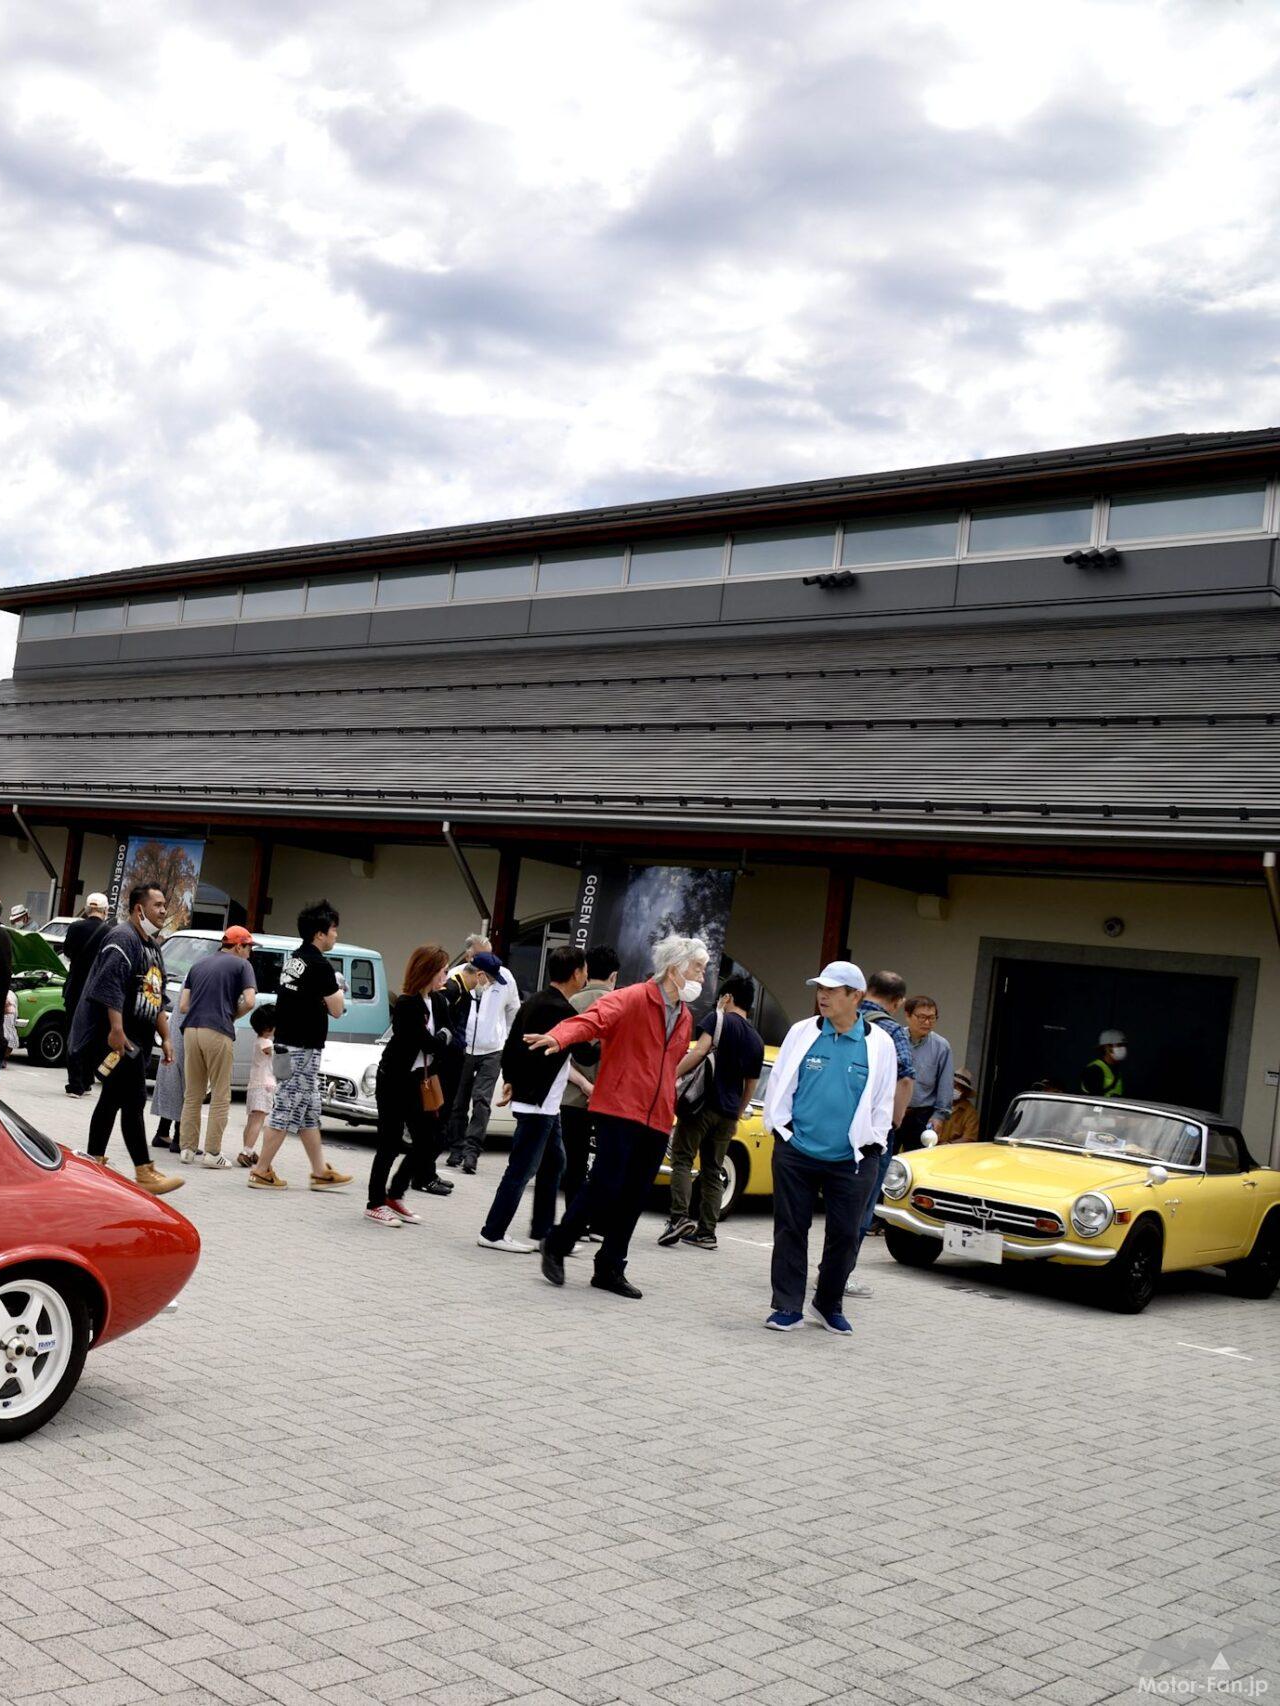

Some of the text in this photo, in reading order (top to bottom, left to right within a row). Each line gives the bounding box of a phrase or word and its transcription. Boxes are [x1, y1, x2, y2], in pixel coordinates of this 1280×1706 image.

[114, 844, 126, 882] GOSEN
[108, 885, 119, 910] CITY
[574, 875, 598, 950] GOSEN CIT
